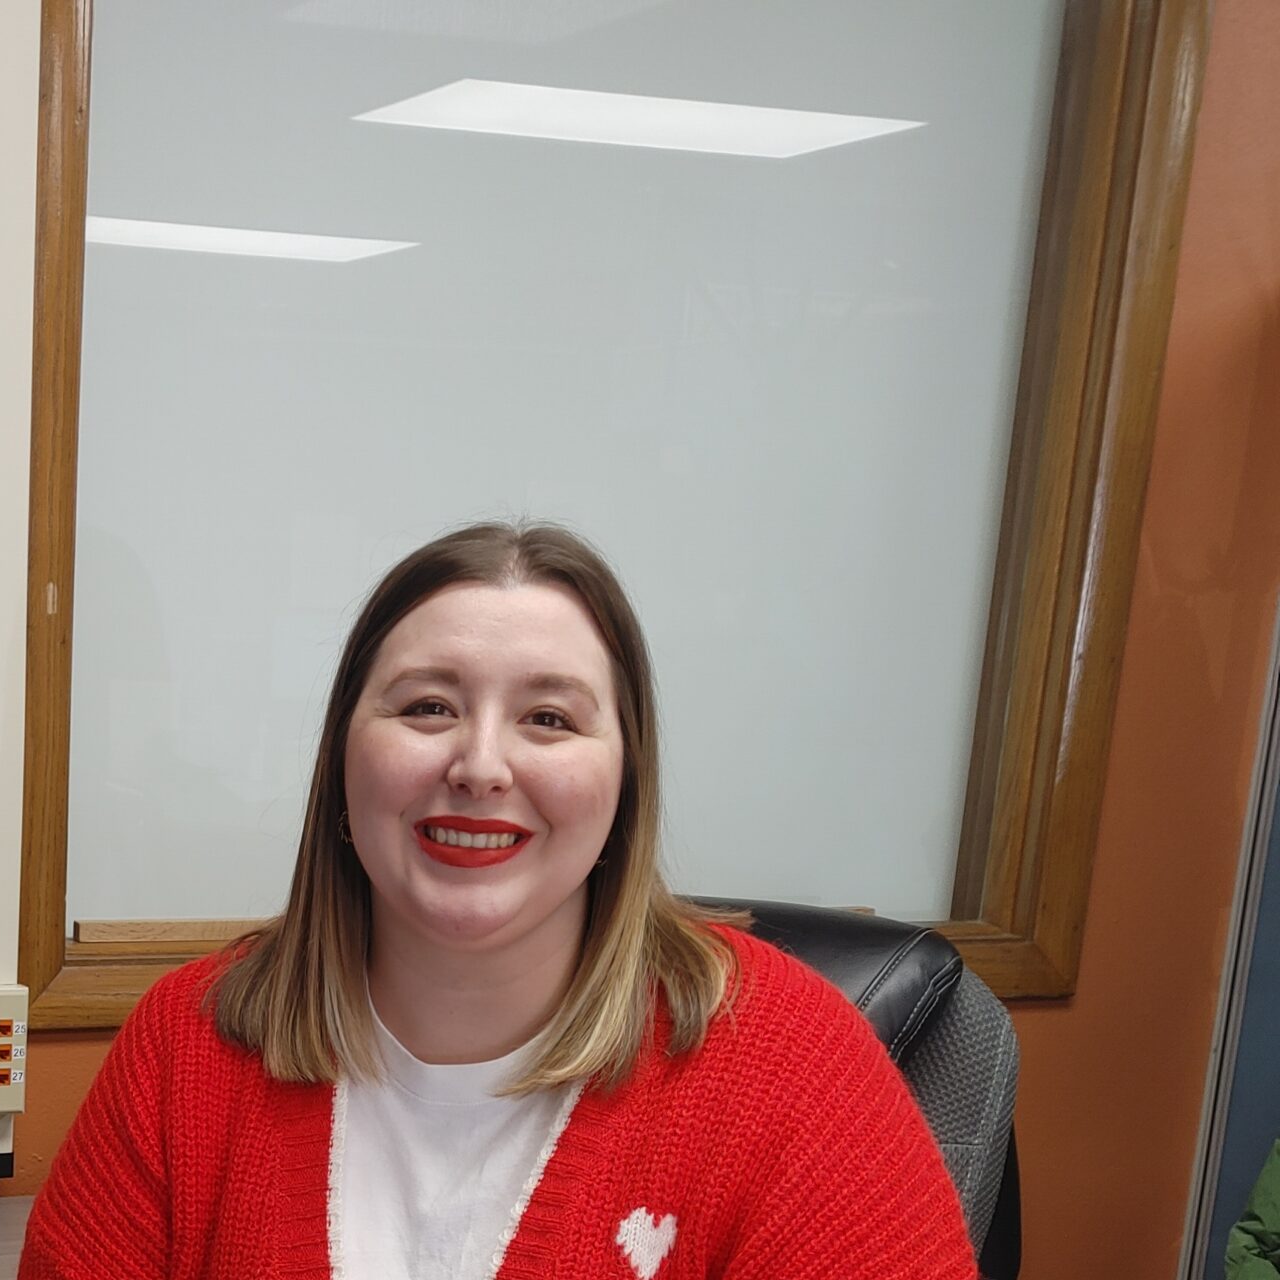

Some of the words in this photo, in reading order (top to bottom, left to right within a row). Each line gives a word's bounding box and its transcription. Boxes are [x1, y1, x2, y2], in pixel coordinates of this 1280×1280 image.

[14, 1024, 26, 1033] 25
[13, 1048, 25, 1057] 26
[12, 1072, 23, 1081] 27
